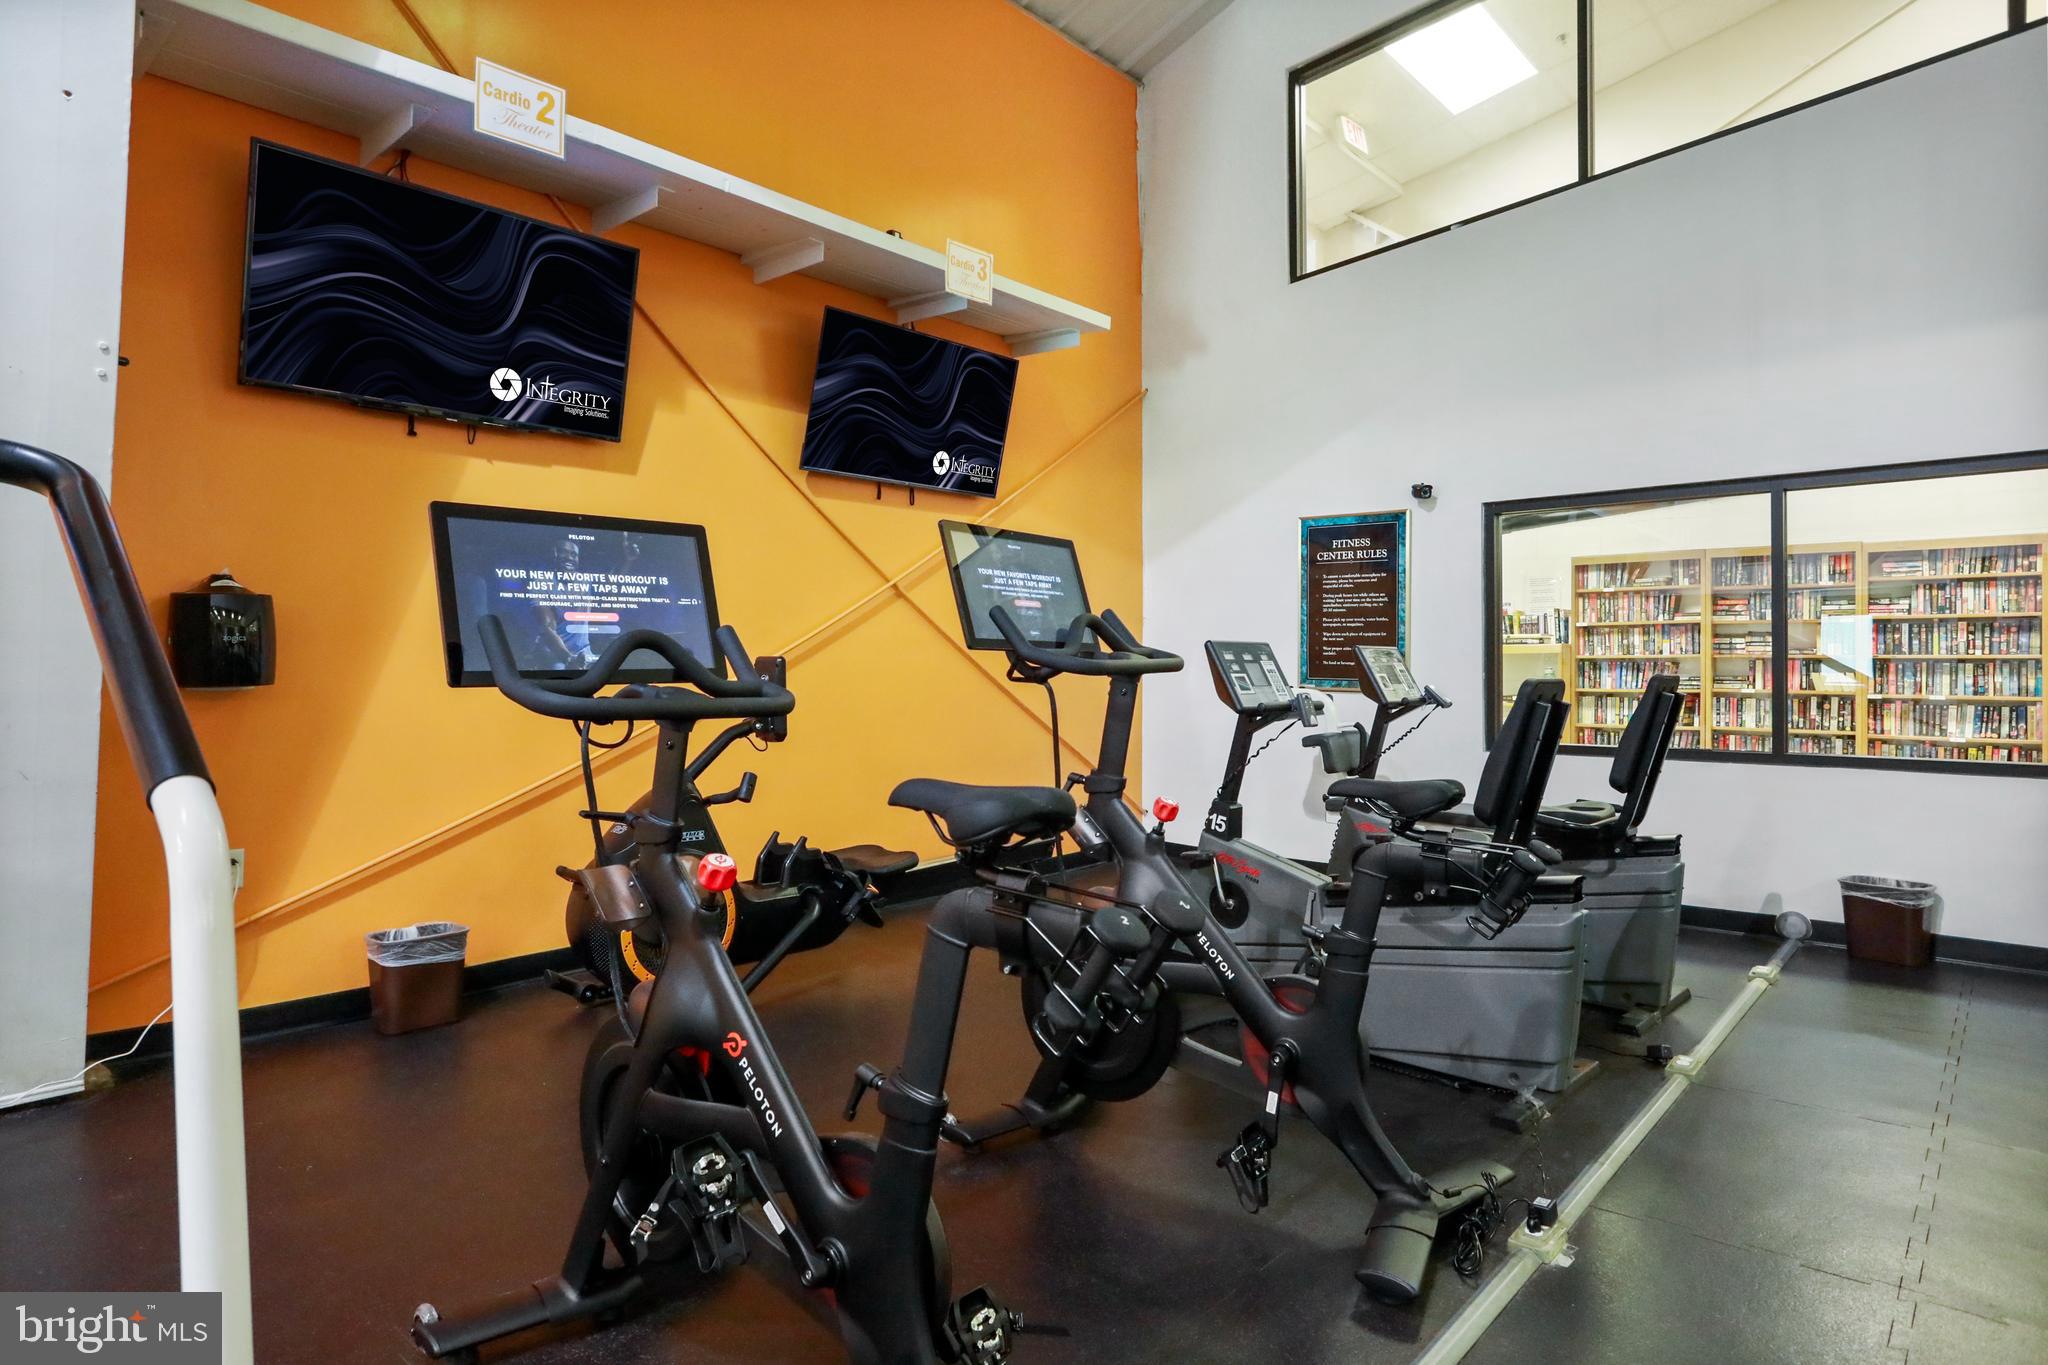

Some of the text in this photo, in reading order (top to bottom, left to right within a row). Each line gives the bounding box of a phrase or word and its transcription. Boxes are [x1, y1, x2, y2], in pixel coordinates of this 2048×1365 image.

[483, 81, 555, 126] Cardio 2
[493, 107, 553, 138] Theater
[951, 256, 975, 272] Cardio
[978, 257, 988, 281] 3
[526, 375, 612, 410] INTEGRITY
[564, 406, 584, 416] Imaging
[951, 454, 996, 478] INTEGRITY
[1332, 538, 1371, 548] FITNESS
[1316, 548, 1388, 561] CENTER RULES
[496, 568, 668, 585] YOUR NEW FAVORITE WORKOUT IS
[978, 568, 993, 576] YOUR
[1006, 571, 1031, 580] FAVORITE
[1031, 574, 1055, 582] WORKOUT
[526, 582, 648, 594] JUST A FEW TAPS AWAY
[1209, 813, 1227, 832] 15
[1120, 915, 1130, 926] 2
[739, 1056, 782, 1138] PELOTON
